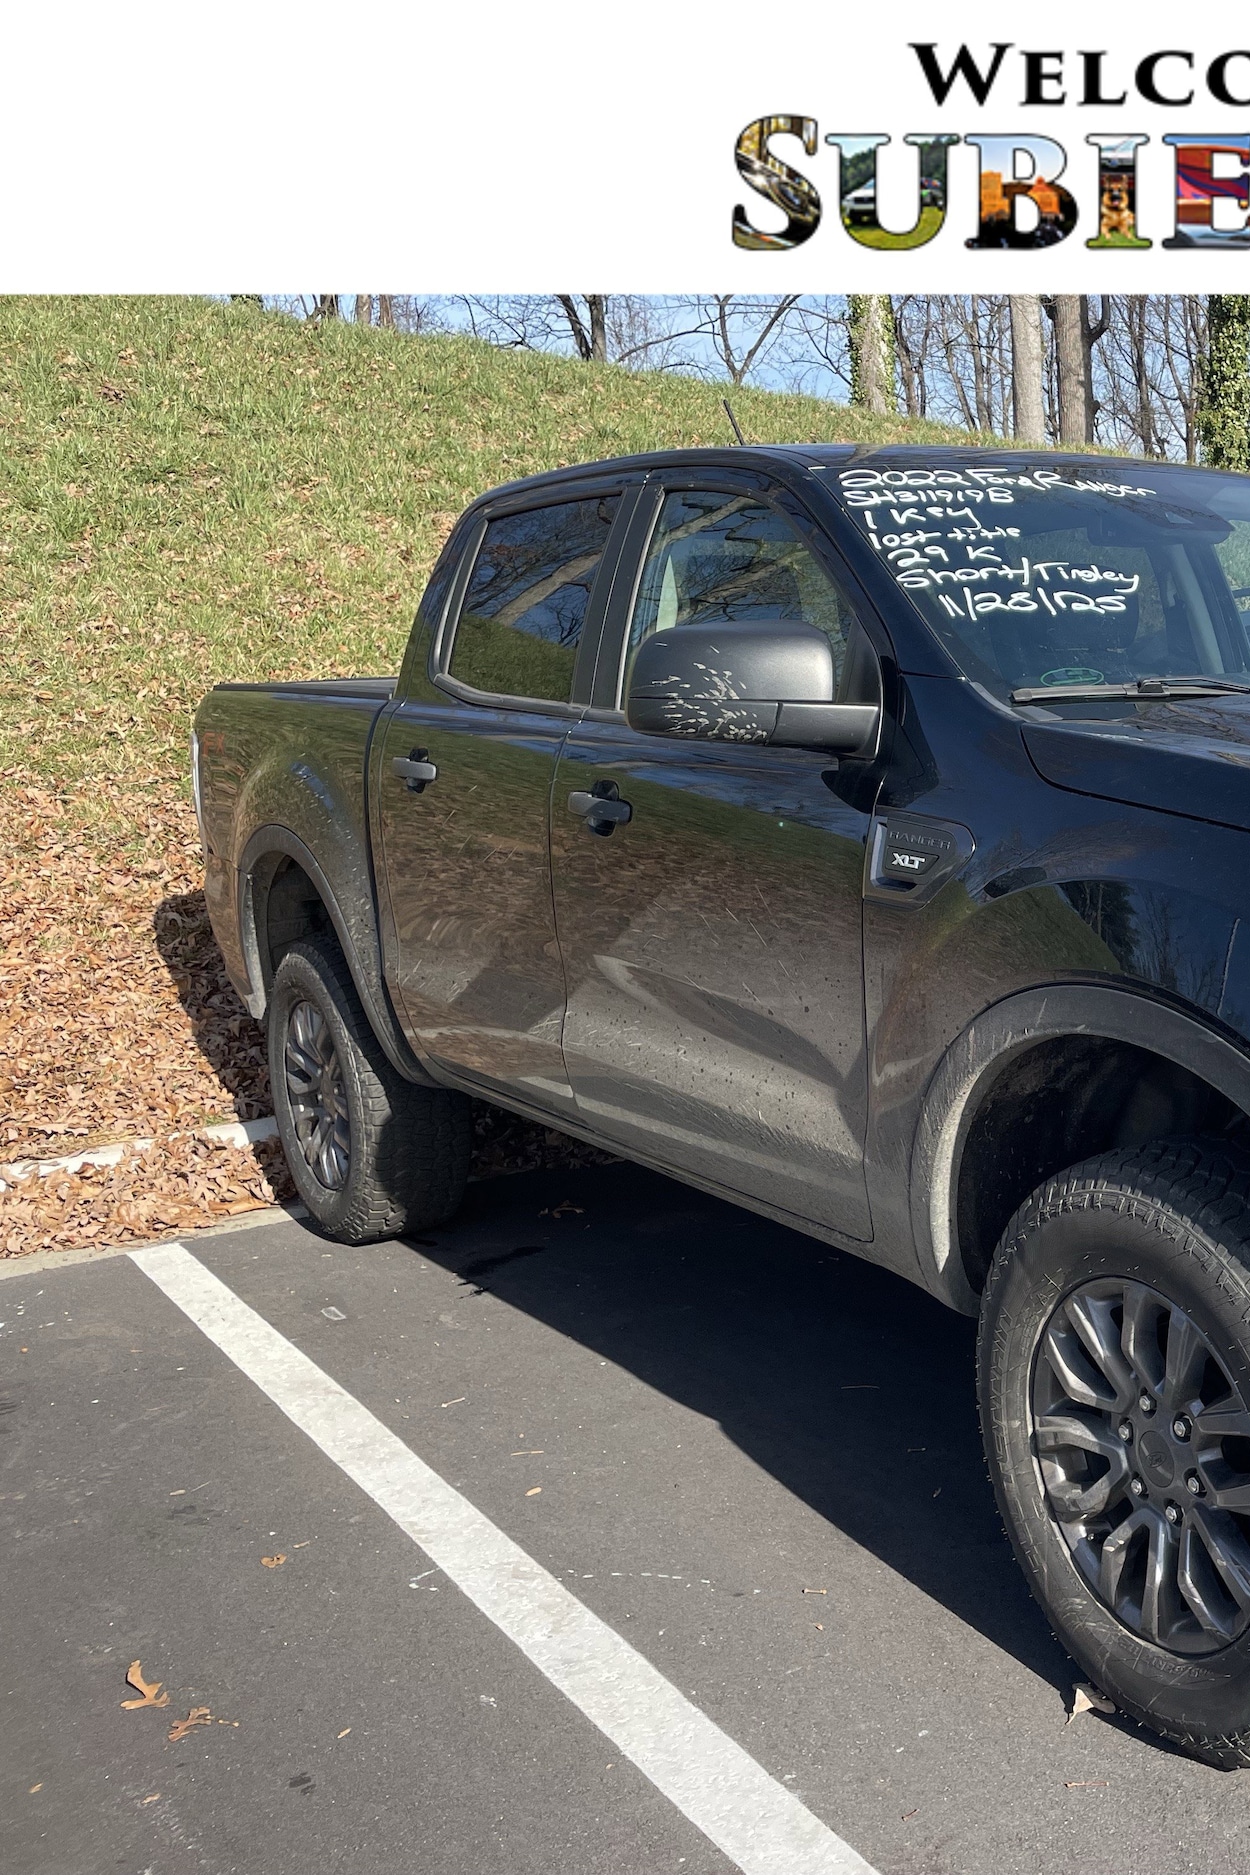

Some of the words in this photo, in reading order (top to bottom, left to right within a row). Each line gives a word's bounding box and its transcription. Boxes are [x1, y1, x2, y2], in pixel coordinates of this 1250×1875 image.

[839, 469, 971, 487] 2022
[965, 468, 1046, 490] Ford
[864, 510, 877, 529] 1
[888, 546, 949, 567] 29
[966, 546, 1002, 561] K
[889, 831, 951, 850] RANGER
[891, 852, 926, 870] XLT
